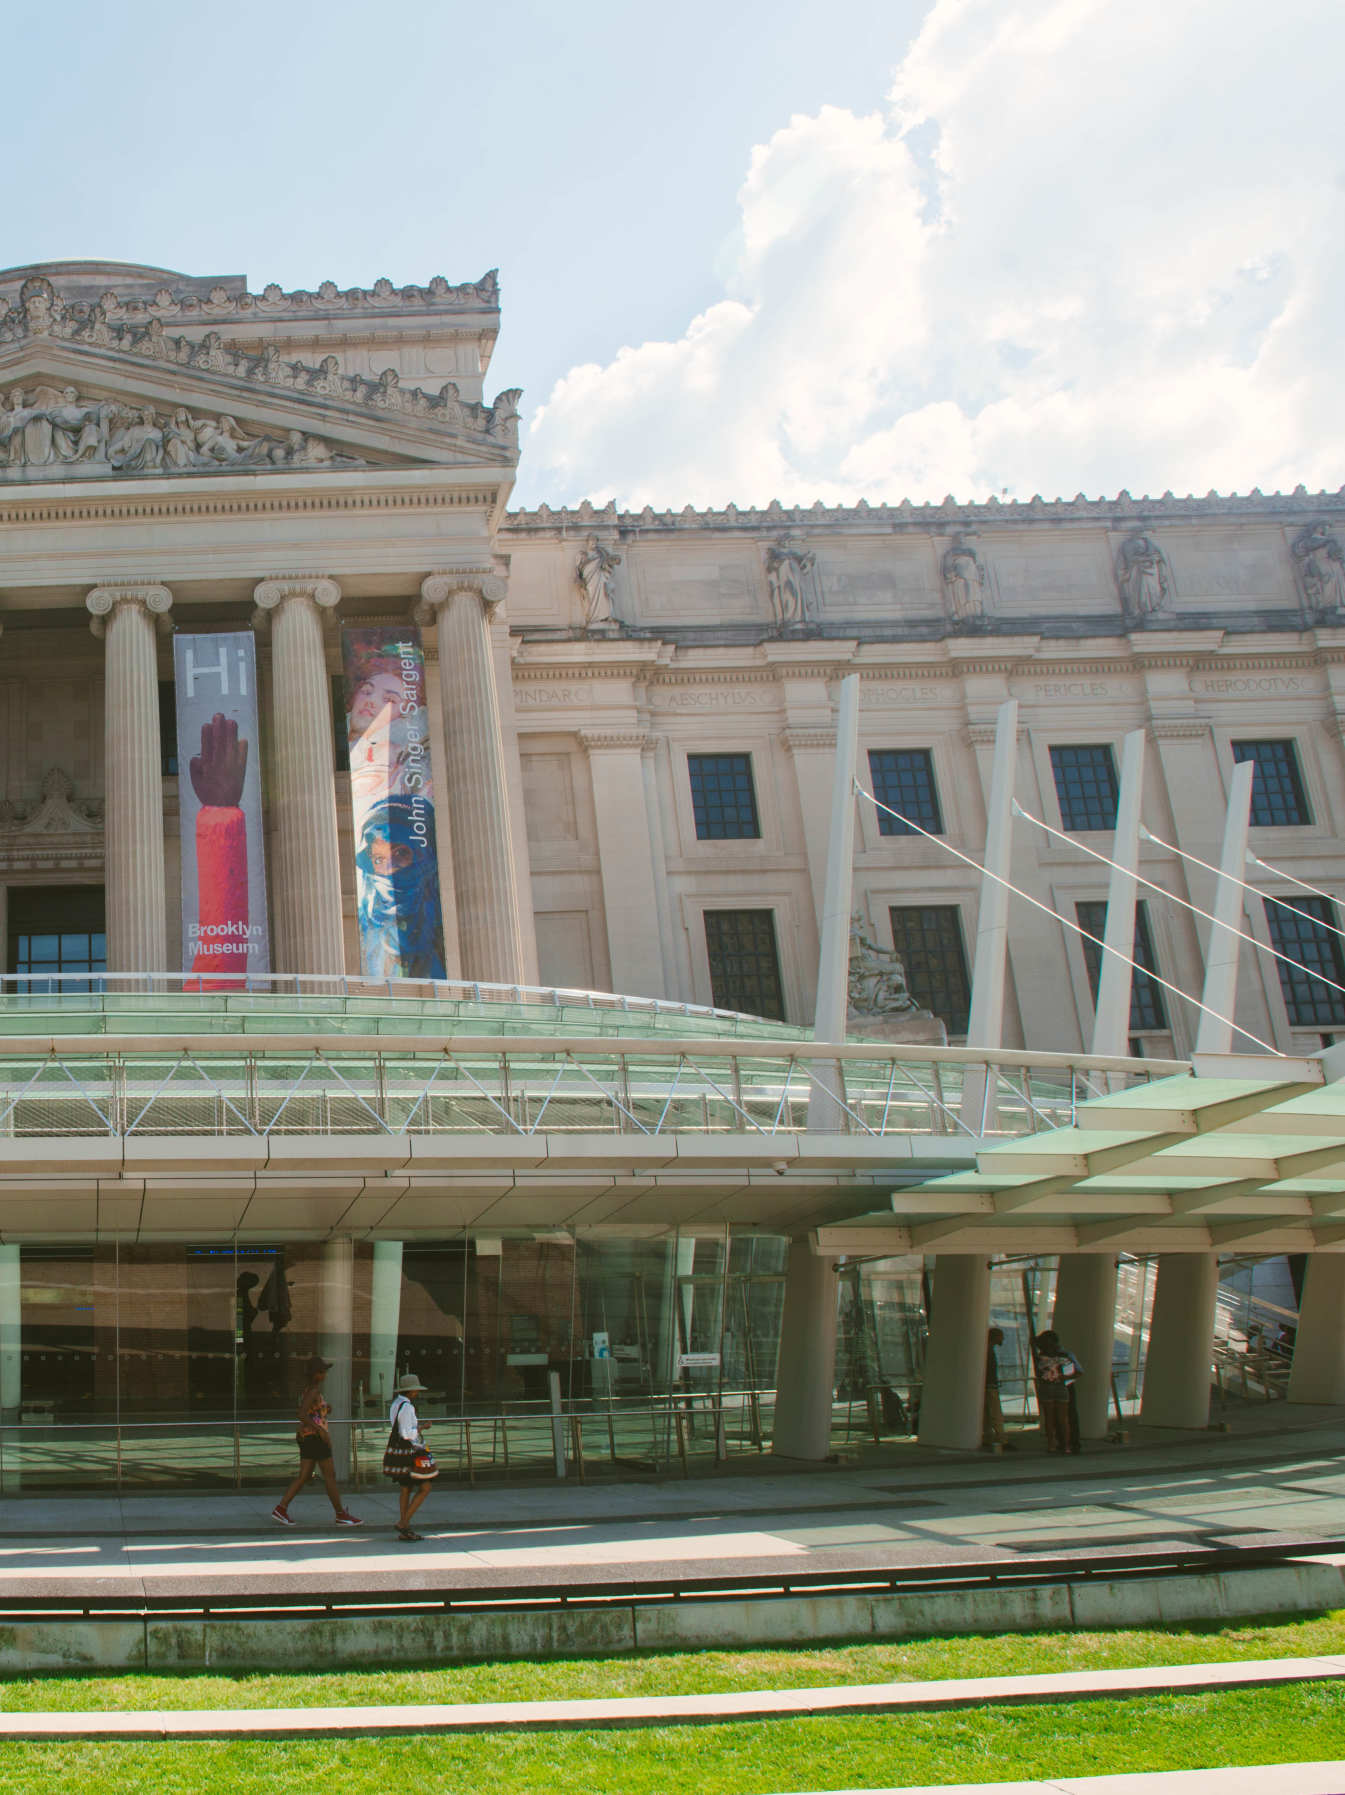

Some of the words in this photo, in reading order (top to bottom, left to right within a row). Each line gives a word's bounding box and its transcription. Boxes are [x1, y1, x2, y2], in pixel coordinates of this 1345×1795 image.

[185, 647, 247, 697] Hi
[395, 641, 419, 715] Sargent
[404, 724, 424, 788] Singer
[407, 796, 428, 848] John
[188, 920, 262, 938] Brooklyn
[188, 940, 259, 956] Museum
